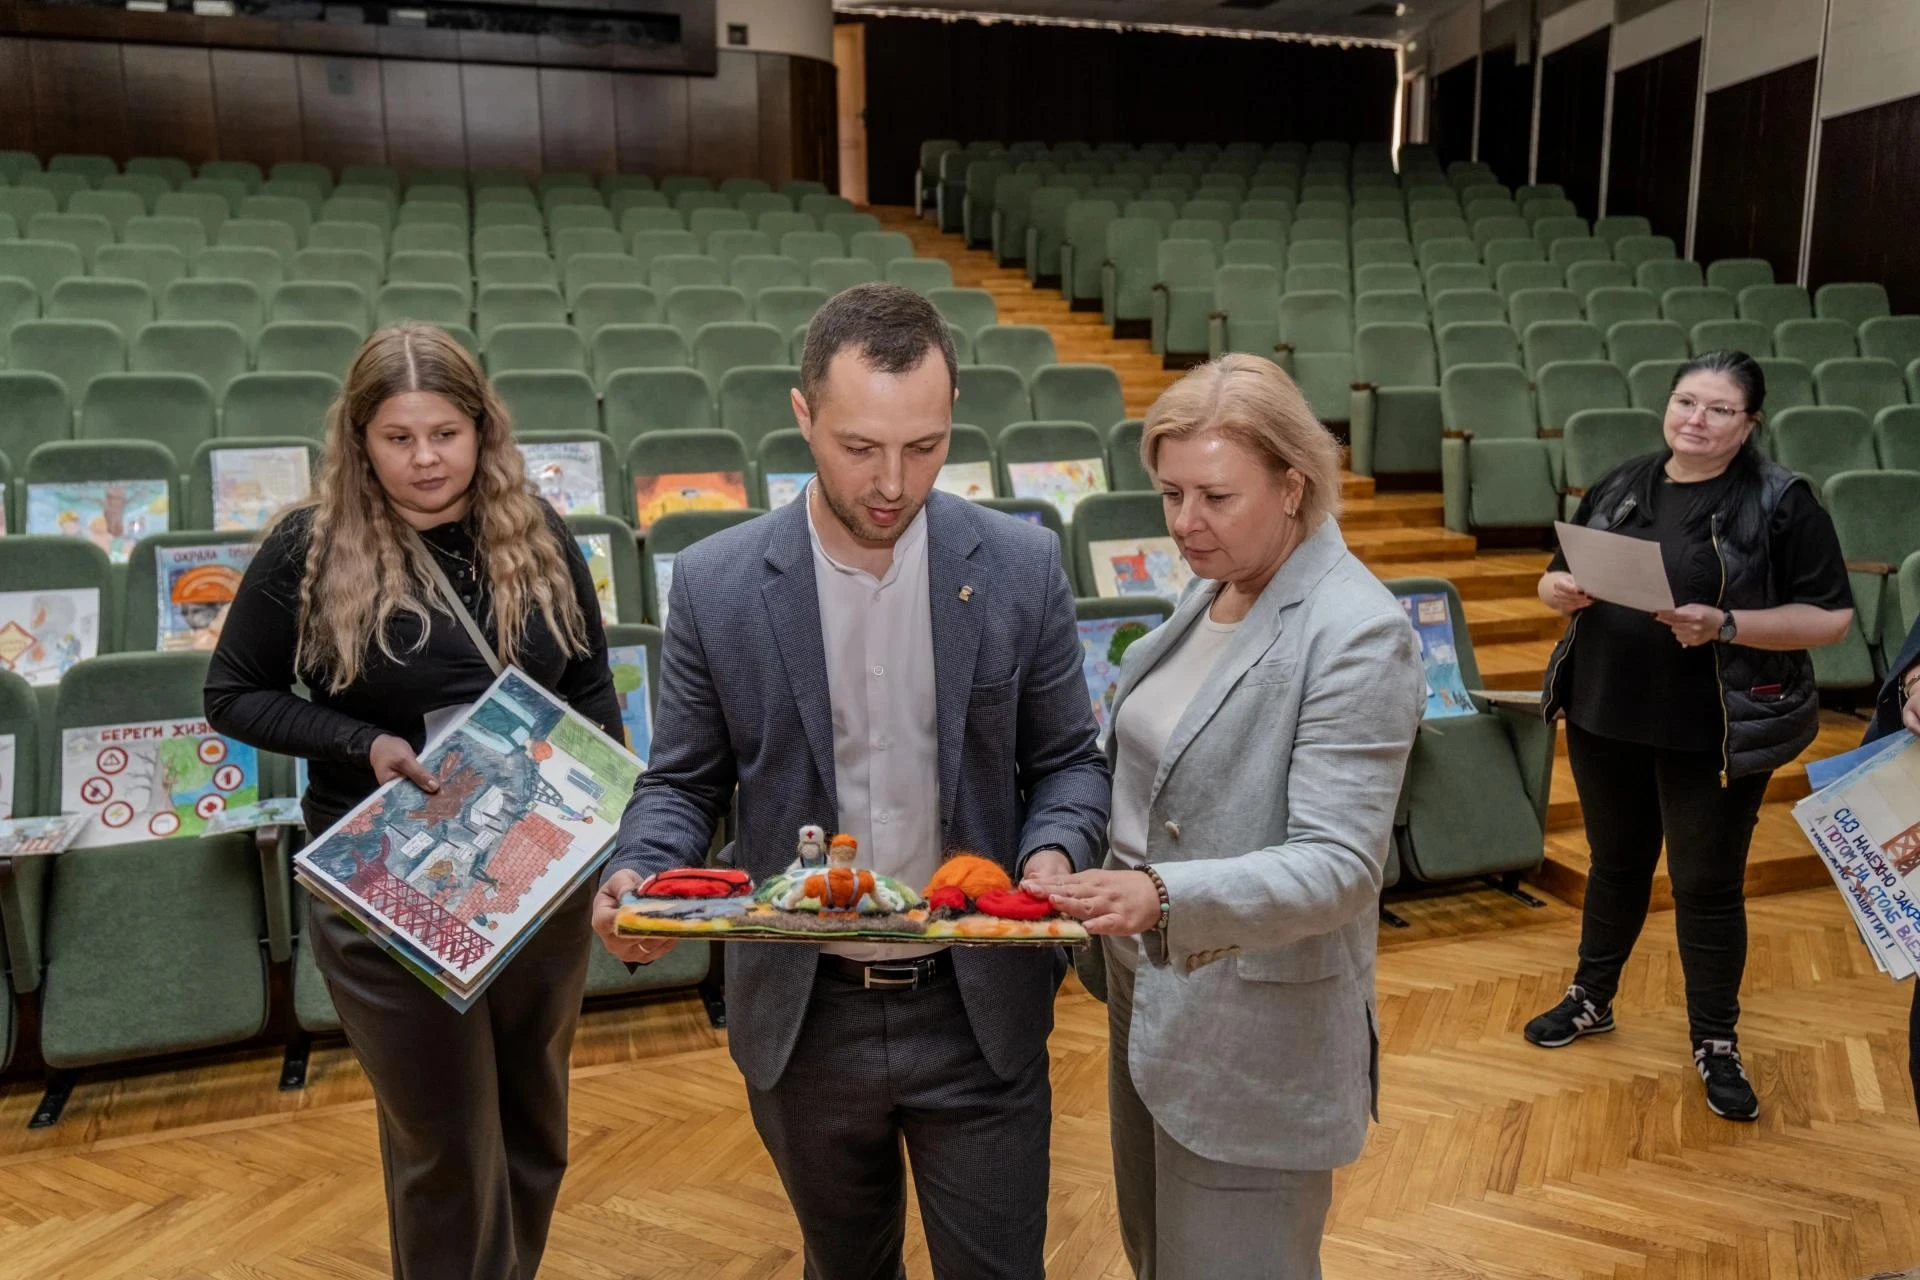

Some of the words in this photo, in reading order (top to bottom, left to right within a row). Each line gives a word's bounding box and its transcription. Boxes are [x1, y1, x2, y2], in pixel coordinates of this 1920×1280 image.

[101, 726, 163, 741] БЕРЕГИ
[1834, 807, 1860, 834] СИЗ
[1815, 815, 1828, 826] А
[1824, 824, 1857, 864] ПОТОМ
[1853, 864, 1871, 885] НА
[1868, 885, 1902, 925] СТОЛБ
[1896, 924, 1920, 963] ВЛЕЗ
